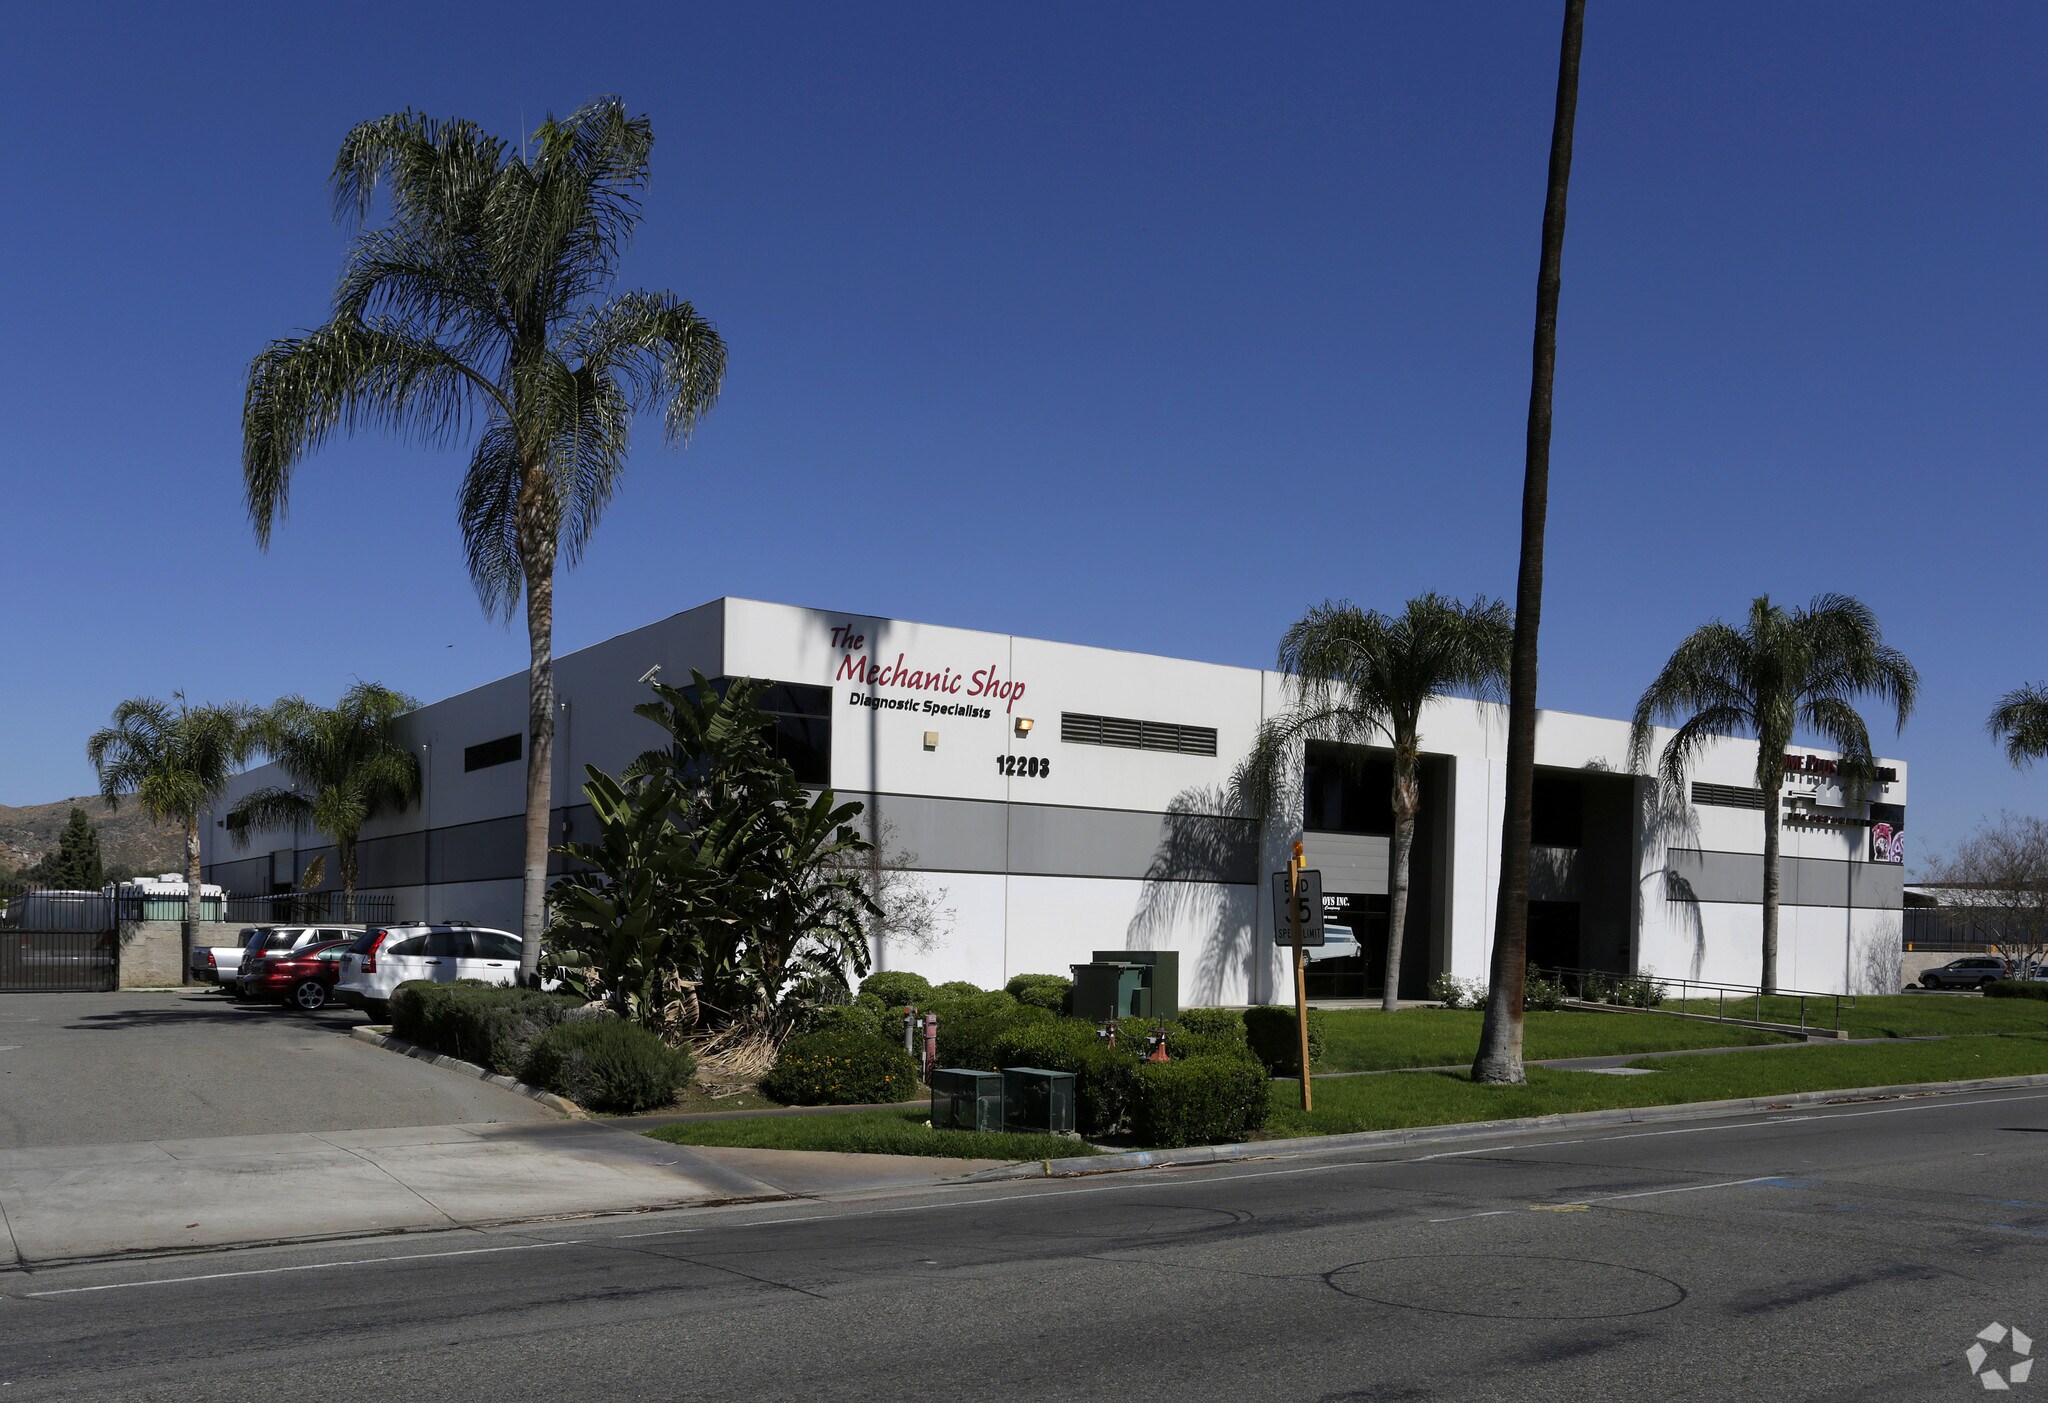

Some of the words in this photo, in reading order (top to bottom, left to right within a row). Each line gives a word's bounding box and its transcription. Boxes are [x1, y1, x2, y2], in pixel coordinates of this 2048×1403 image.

[830, 623, 865, 650] The
[836, 652, 963, 694] Mechanic
[966, 664, 1026, 714] Shop
[849, 691, 921, 712] Diagnostic
[921, 699, 992, 720] Specialists
[996, 754, 1051, 779] 12203
[1284, 878, 1309, 893] ED
[1278, 928, 1296, 939] SPE
[1302, 928, 1321, 939] LIMIT
